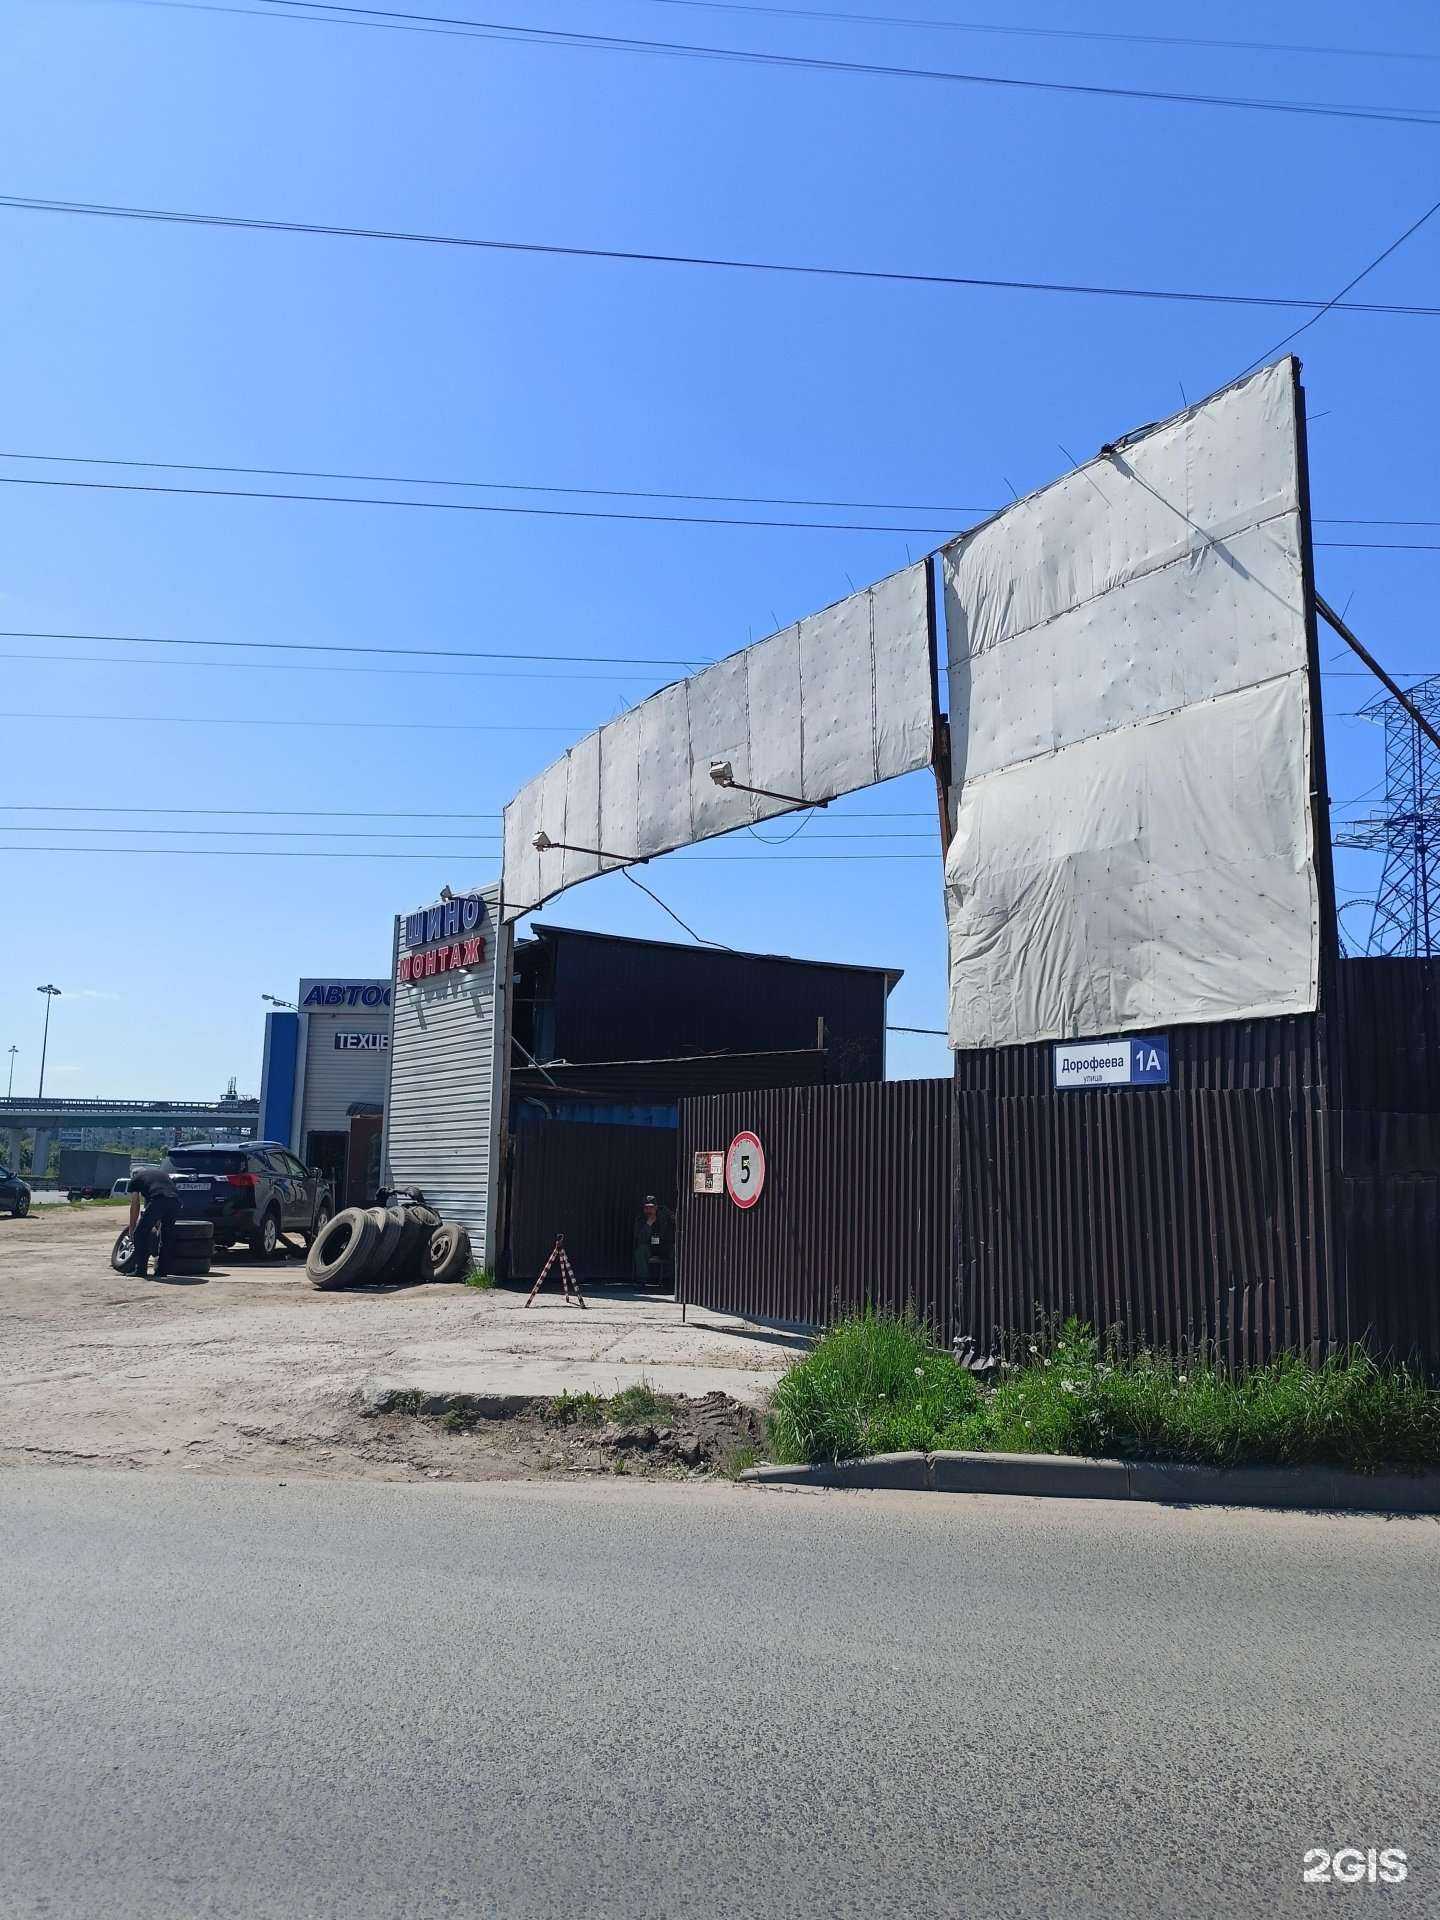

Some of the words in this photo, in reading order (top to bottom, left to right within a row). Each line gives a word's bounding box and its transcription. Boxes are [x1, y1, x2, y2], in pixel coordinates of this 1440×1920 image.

[405, 894, 483, 948] ШИНО
[400, 937, 484, 981] МОНТАЖ
[1061, 1056, 1124, 1073] Дорофеева
[1135, 1049, 1161, 1072] 1А
[1083, 1074, 1103, 1084] улица
[740, 1155, 751, 1184] 5
